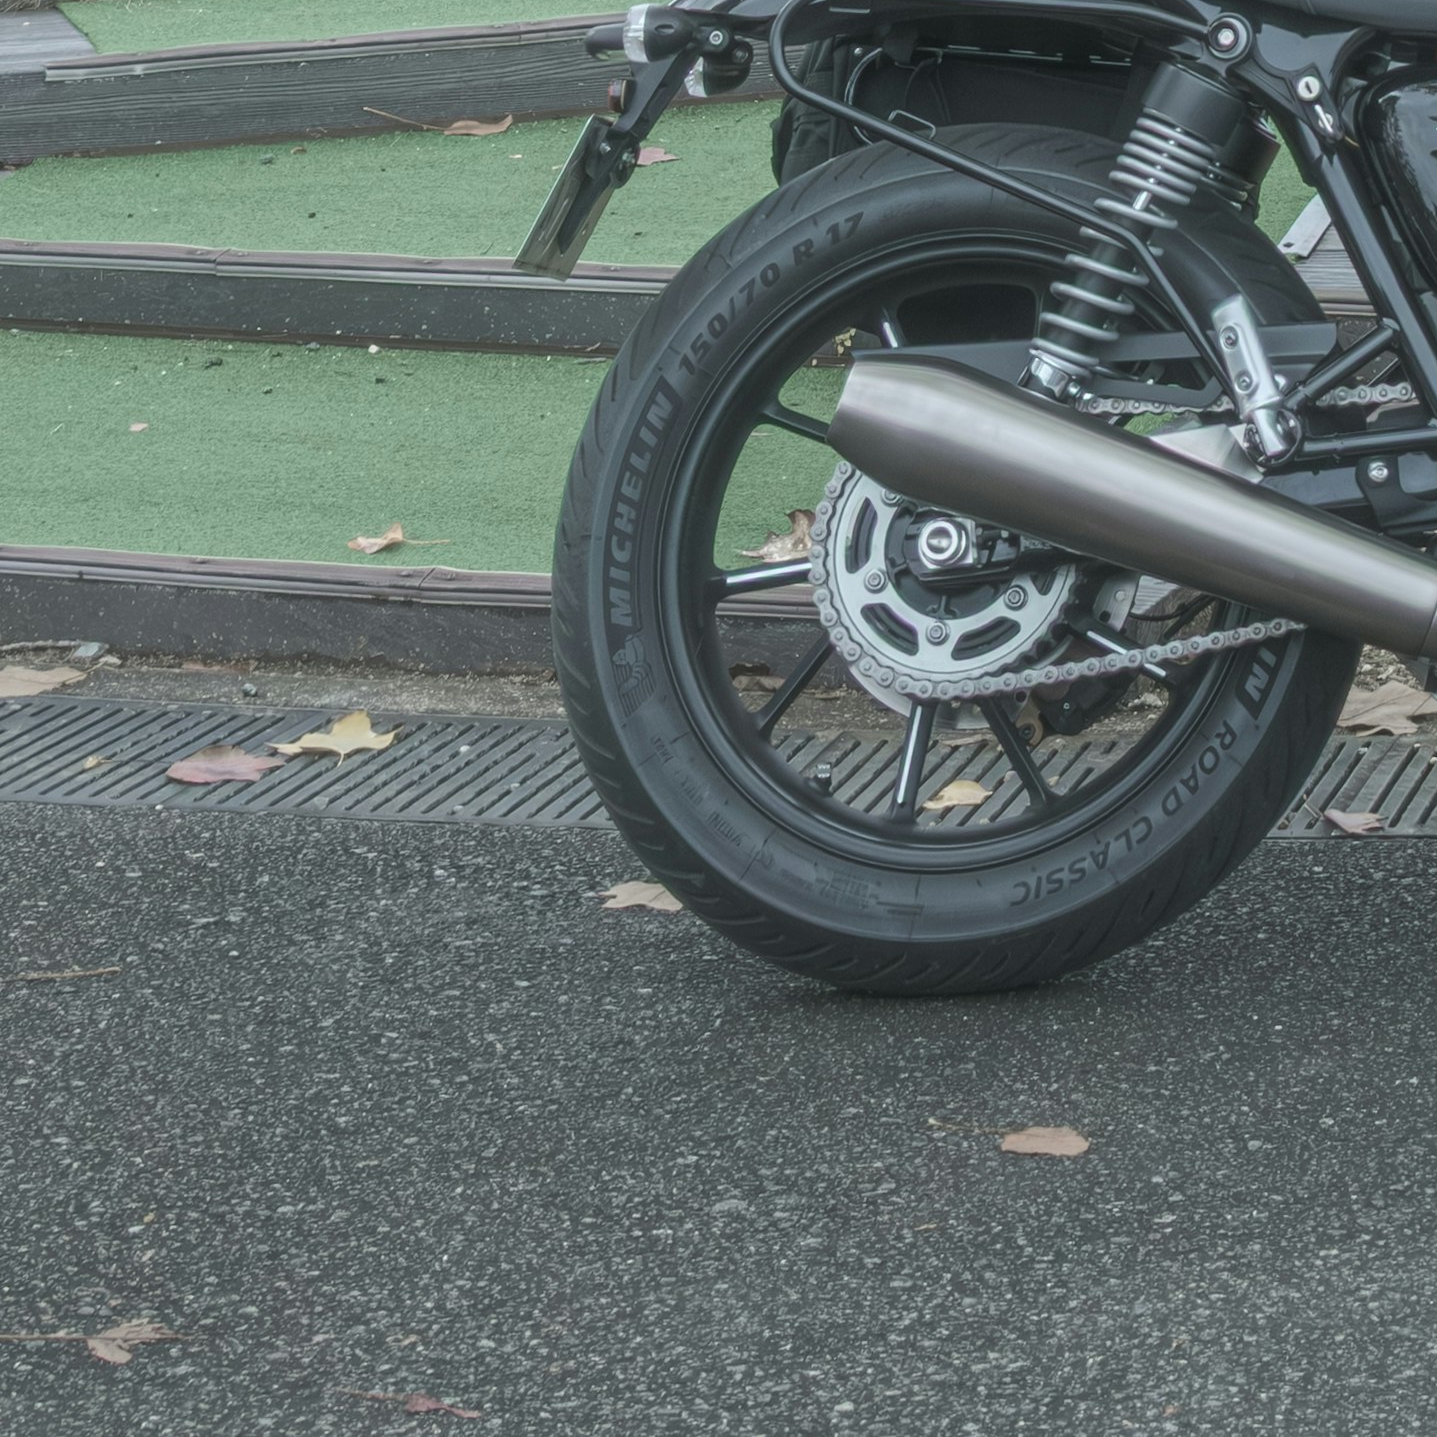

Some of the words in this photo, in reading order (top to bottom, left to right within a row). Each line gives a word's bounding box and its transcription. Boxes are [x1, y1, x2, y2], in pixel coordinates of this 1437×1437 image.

[610, 393, 675, 628] MICHELIN
[676, 262, 782, 378] 150/70
[792, 237, 815, 267] R
[825, 211, 865, 245] 17
[1161, 718, 1239, 817] ROAD
[1009, 815, 1154, 908] CLASSIC
